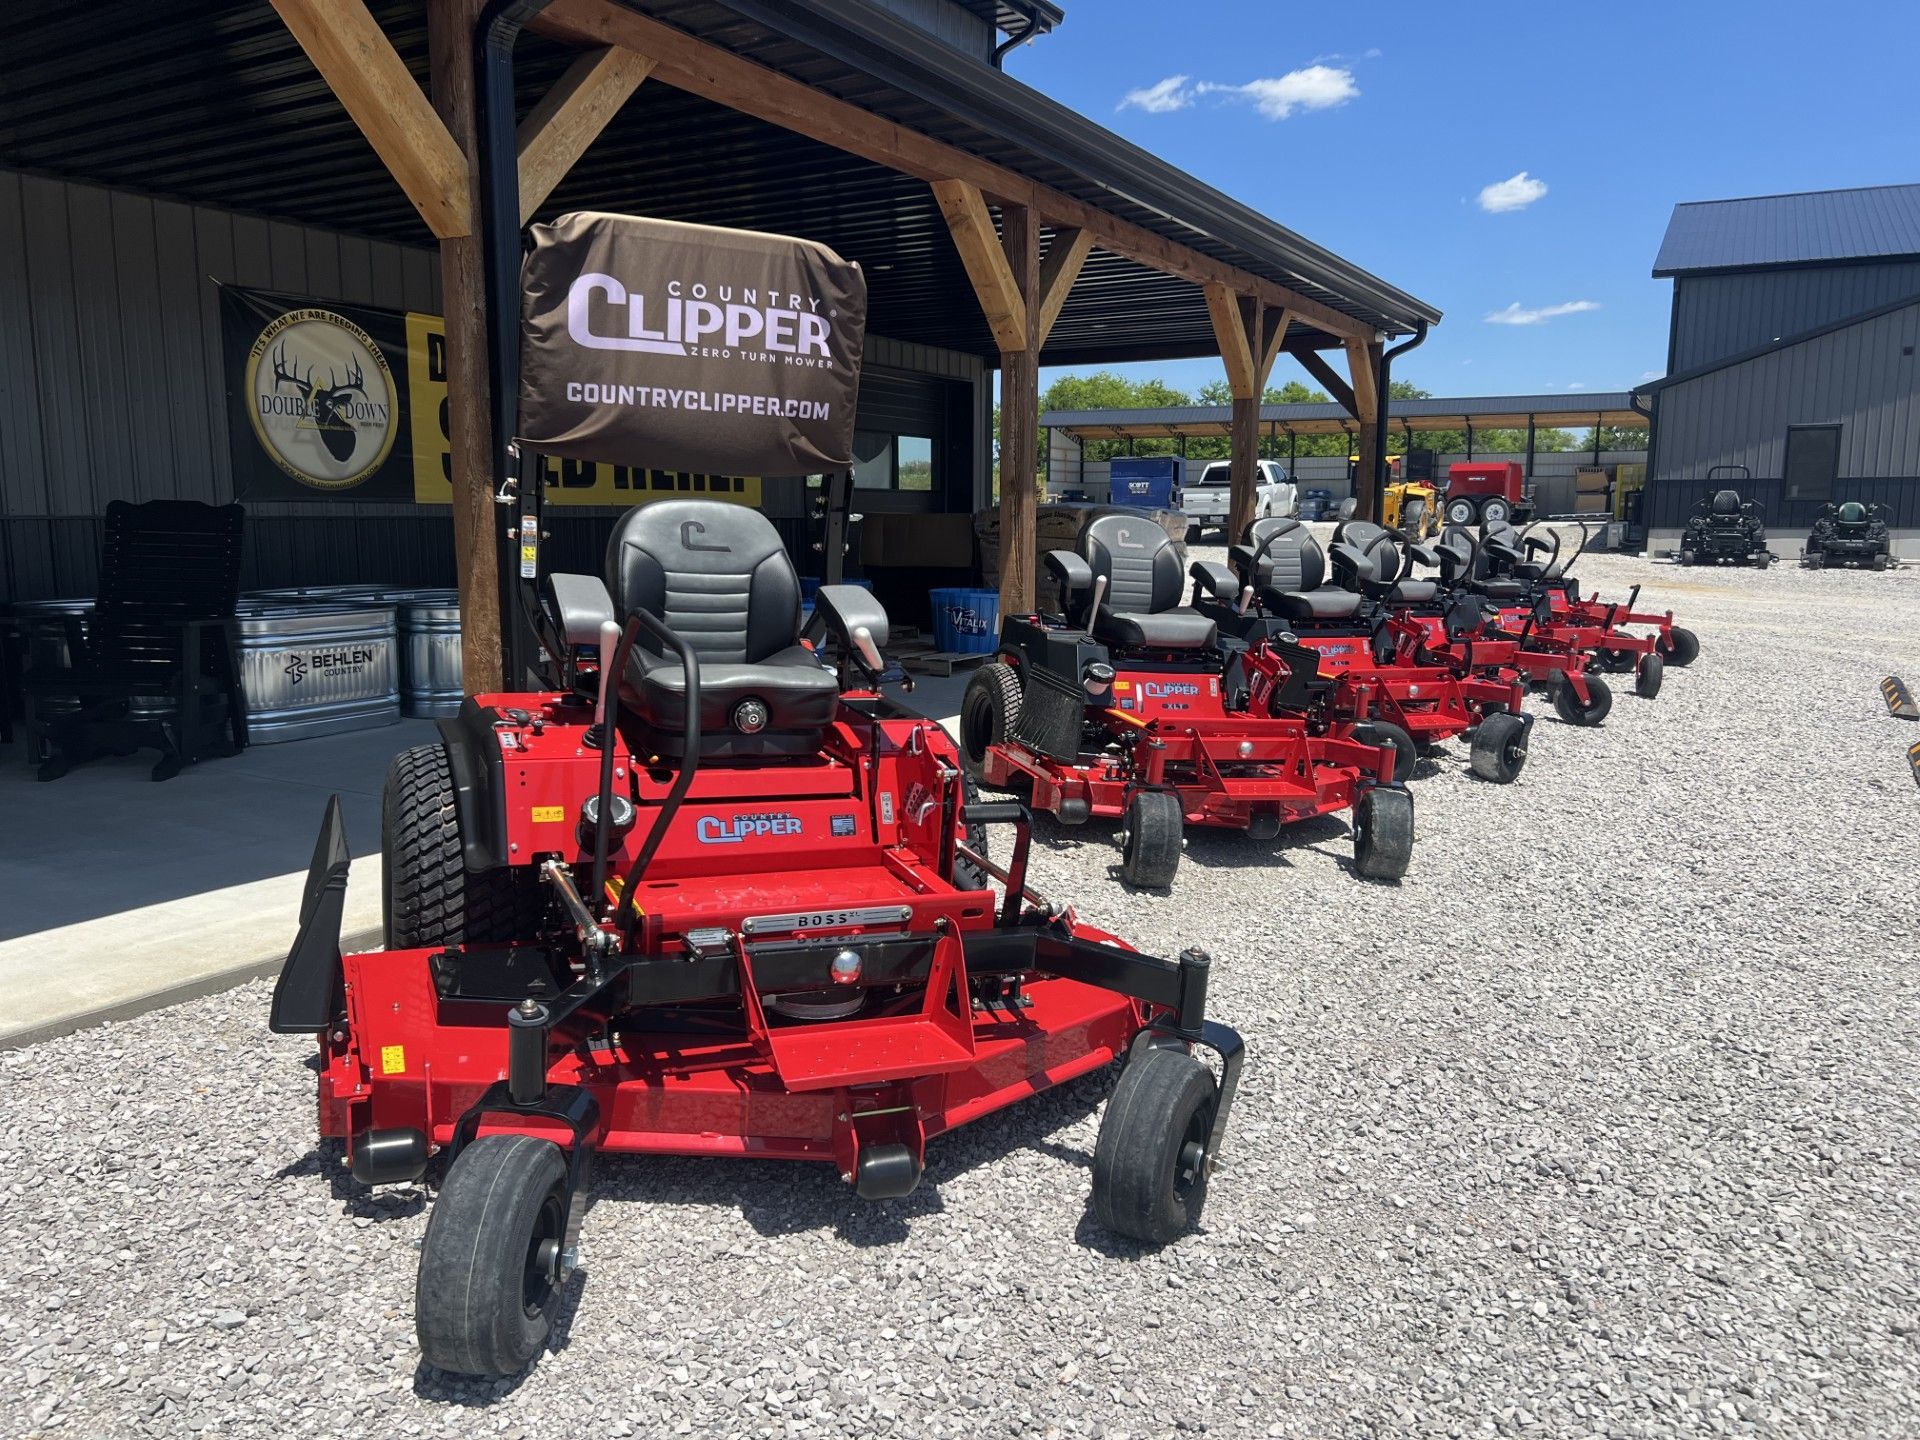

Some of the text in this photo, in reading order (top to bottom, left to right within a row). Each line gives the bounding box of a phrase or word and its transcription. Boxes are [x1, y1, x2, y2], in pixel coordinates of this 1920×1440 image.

[667, 281, 820, 313] COUNTRY
[263, 316, 289, 339] WHAT
[289, 311, 306, 322] WE
[308, 310, 327, 320] ARE
[328, 313, 369, 343] FEEDING
[568, 272, 831, 357] CLIPPER
[691, 346, 833, 370] ZERO TURN MOWER
[261, 394, 388, 420] DOUBLE DOWN
[567, 382, 829, 421] COUNTRYCLIPPER.COM
[311, 649, 373, 668] BEHLEN
[324, 665, 363, 677] COUNTRY
[1145, 682, 1200, 697] CLIPPER
[732, 812, 791, 821] COUNTRY
[696, 815, 803, 844] CLIPPER
[797, 913, 848, 927] BOSS
